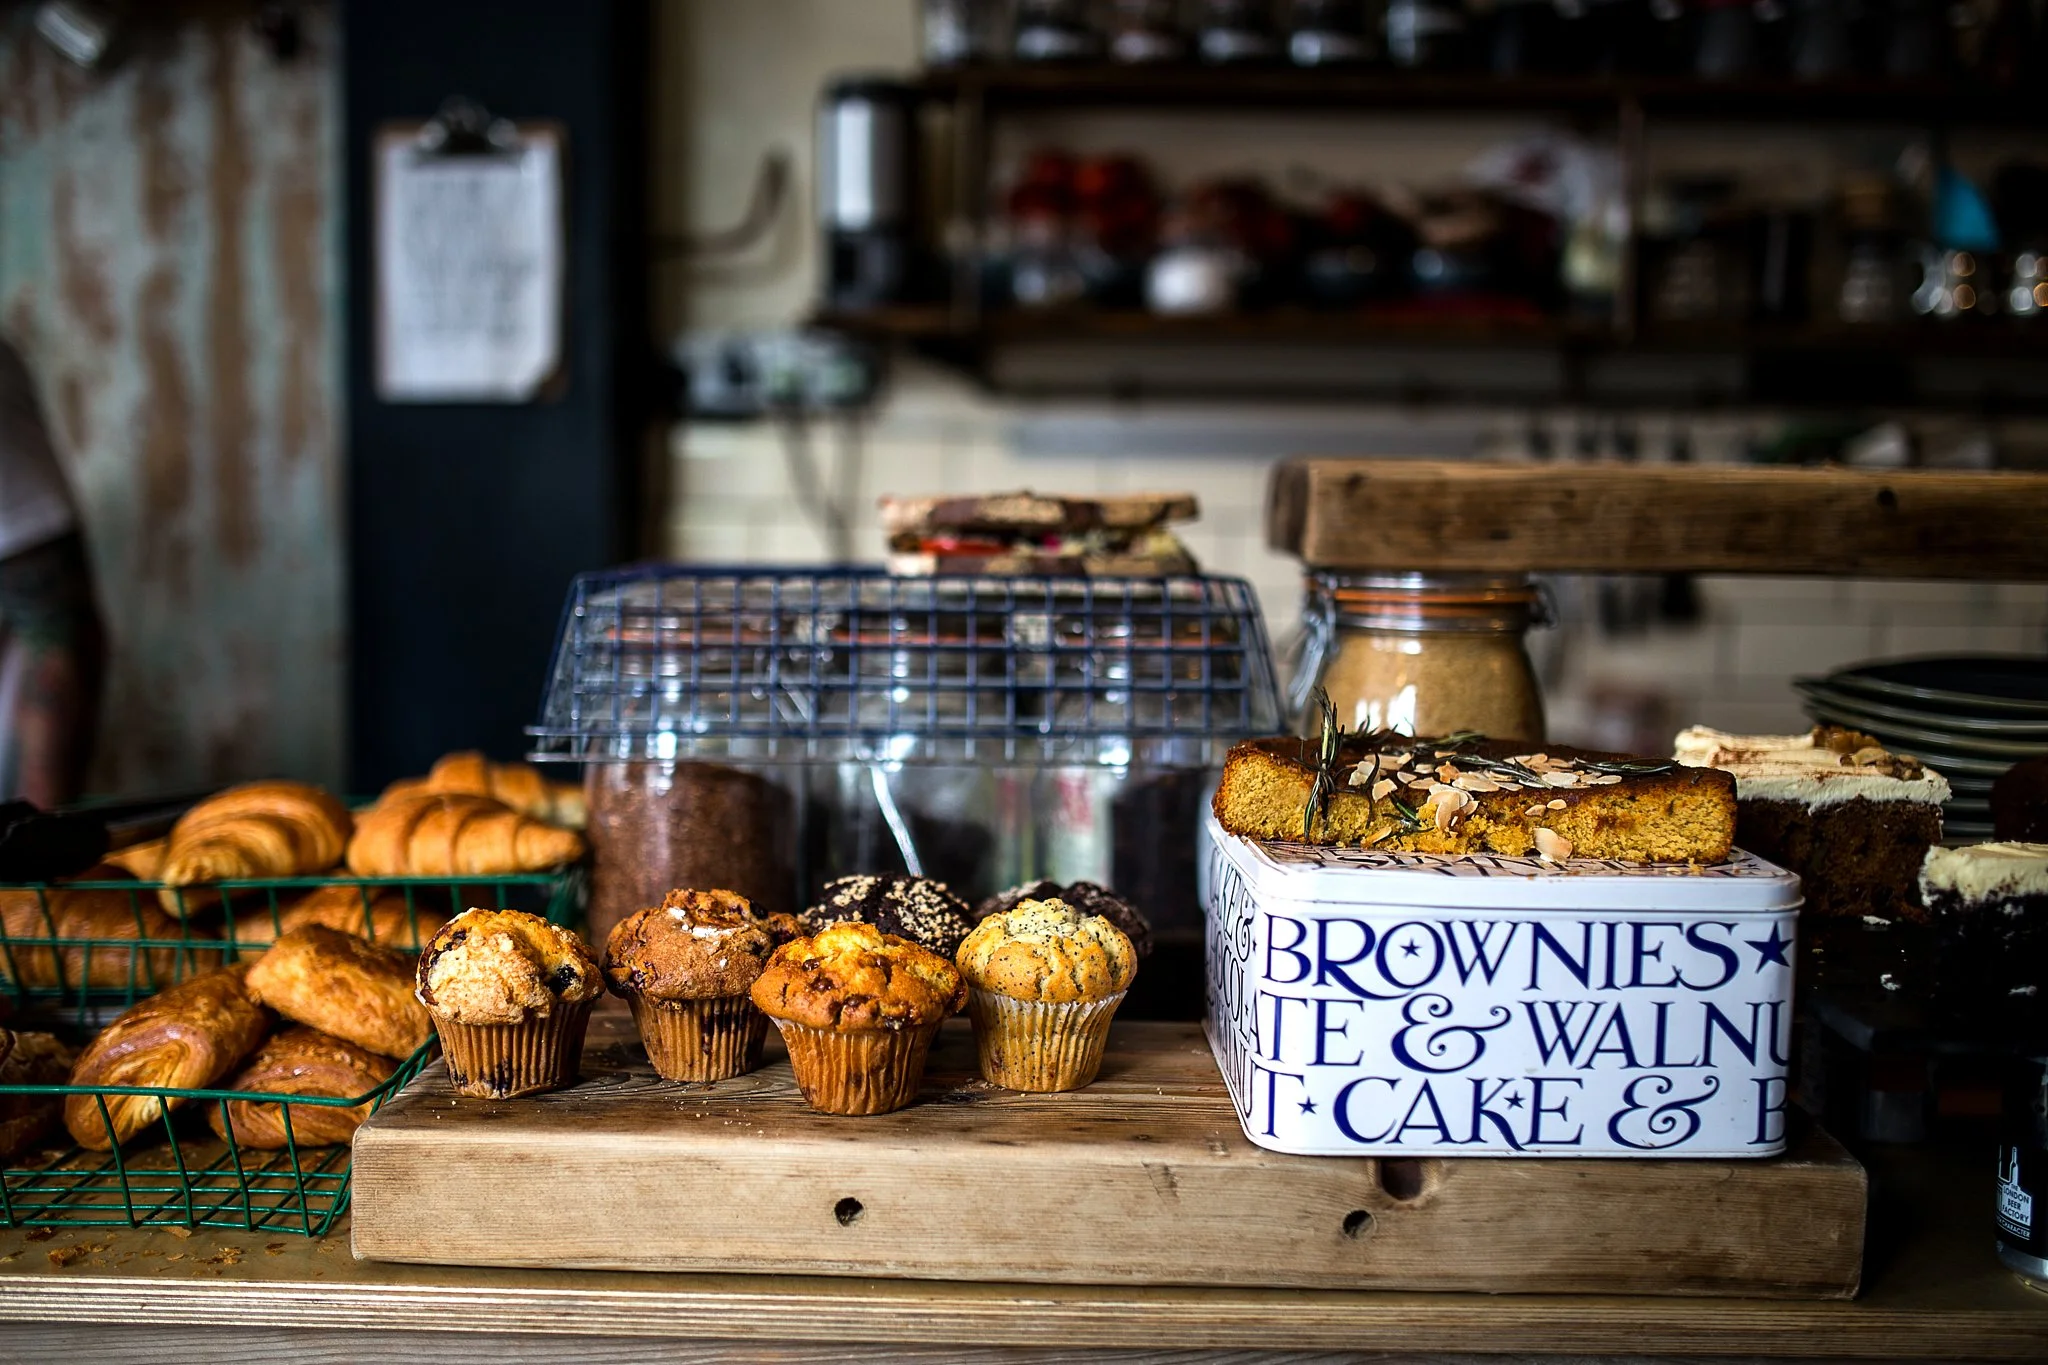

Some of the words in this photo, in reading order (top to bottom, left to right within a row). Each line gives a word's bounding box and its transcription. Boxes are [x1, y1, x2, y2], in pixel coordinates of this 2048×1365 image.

[1262, 913, 1740, 1000] BROWNIES
[1391, 993, 1512, 1074] &
[1333, 1077, 1584, 1151] CAKE
[1608, 1075, 1720, 1150] &
[2002, 1204, 2029, 1223] FACTORY
[2003, 1186, 2029, 1204] LONDON
[2007, 1198, 2021, 1211] BEER
